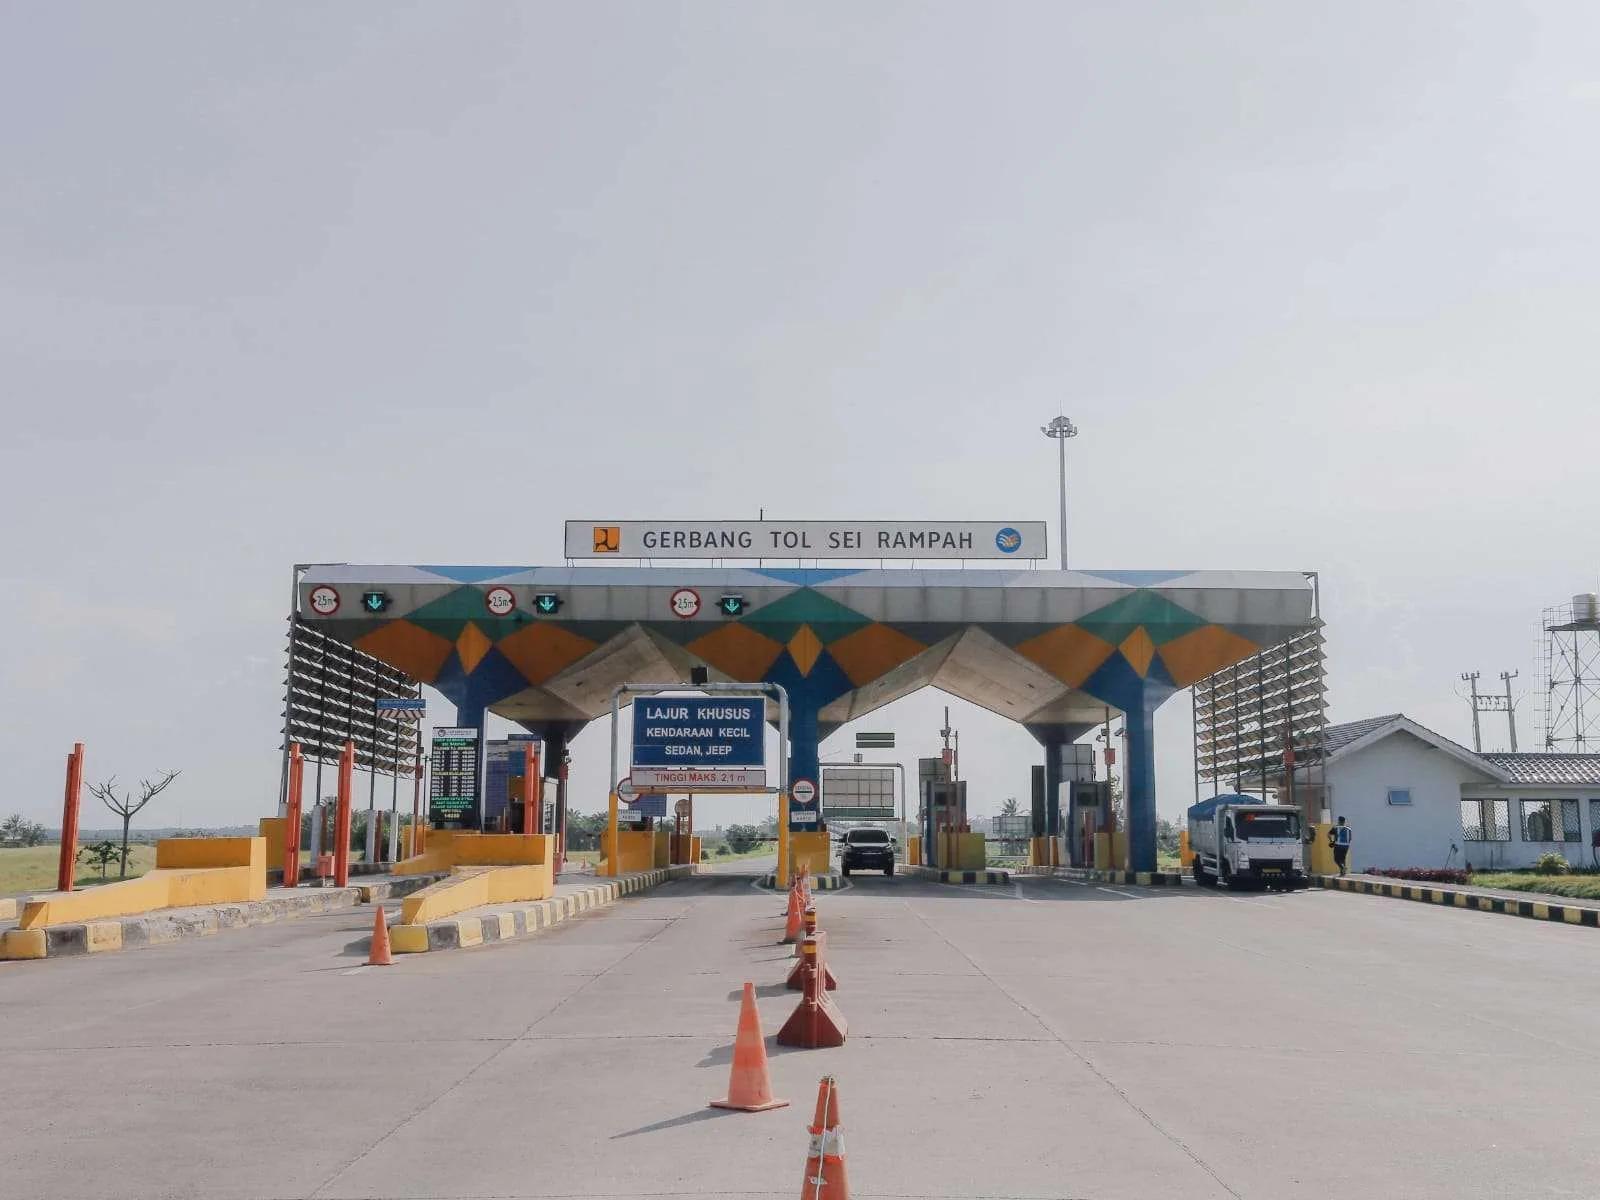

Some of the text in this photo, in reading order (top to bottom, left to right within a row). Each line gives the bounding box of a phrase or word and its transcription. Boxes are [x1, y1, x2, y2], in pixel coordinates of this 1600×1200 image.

[643, 531, 973, 549] GERBANG TOL SEI RAMPAH
[646, 707, 751, 720] LAJUR KHUSUS
[646, 727, 751, 738] KENDARAAN KECIL
[664, 745, 732, 757] SEDAN, JEEP
[655, 773, 687, 783] TINGGI
